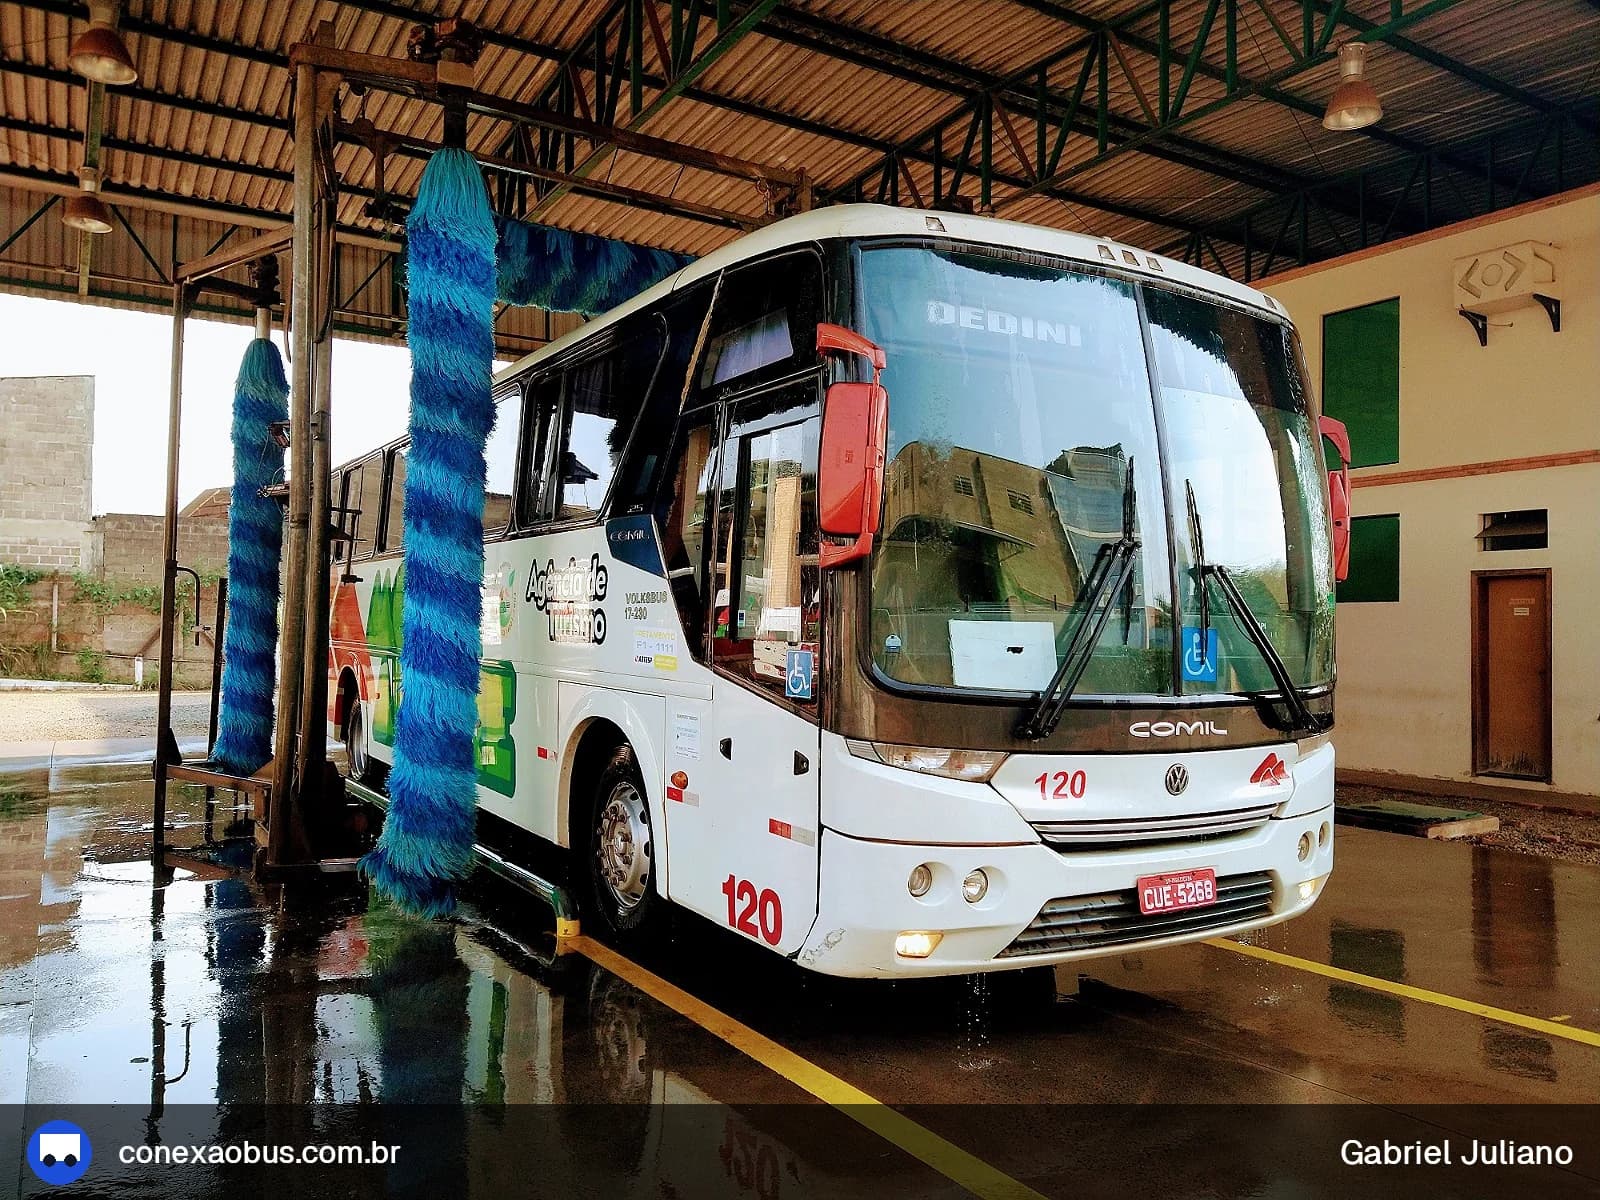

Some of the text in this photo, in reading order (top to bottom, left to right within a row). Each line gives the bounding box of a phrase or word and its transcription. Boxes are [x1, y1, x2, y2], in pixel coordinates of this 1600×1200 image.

[927, 300, 1082, 347] DEDINI
[587, 552, 608, 602] de
[625, 591, 668, 605] VOLKSBUS
[1129, 721, 1228, 738] COMIL
[1034, 770, 1087, 801] 120
[722, 873, 783, 946] 120
